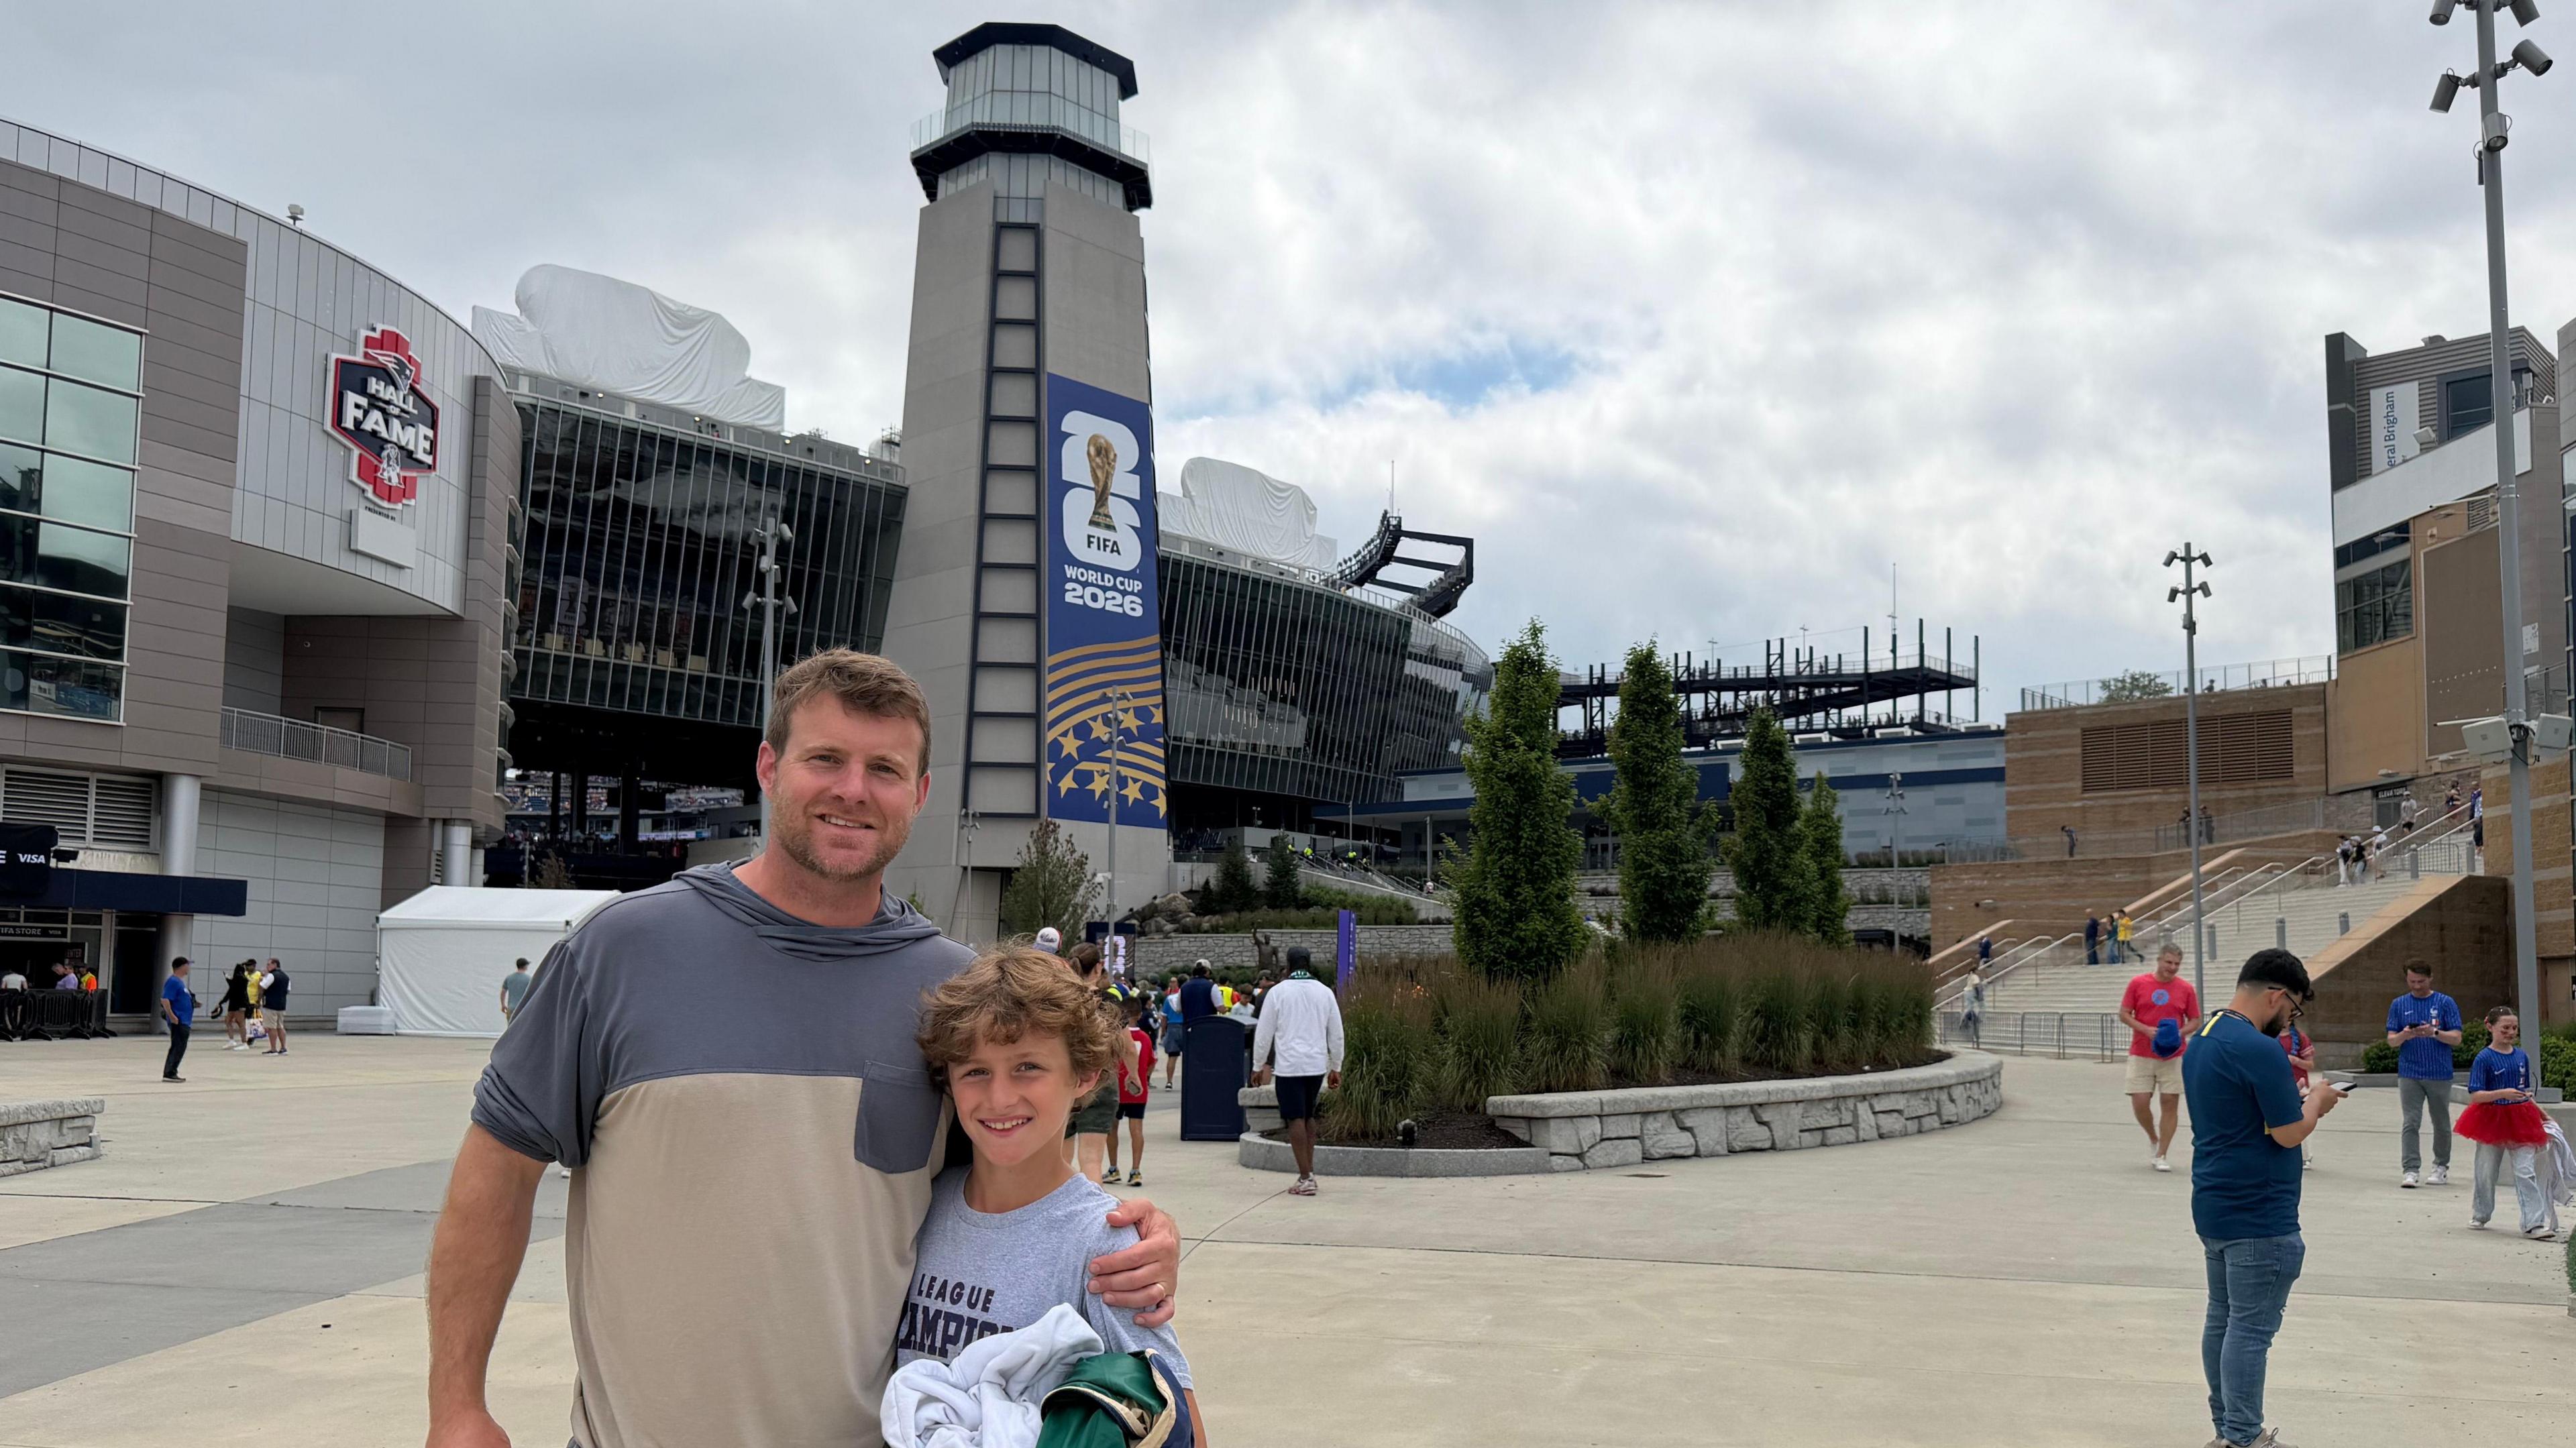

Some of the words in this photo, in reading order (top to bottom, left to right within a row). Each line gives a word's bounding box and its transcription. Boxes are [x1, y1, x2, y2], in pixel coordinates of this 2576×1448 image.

[367, 376, 418, 414] HALL
[386, 405, 401, 415] OF
[341, 390, 434, 465] FAME
[2383, 391, 2398, 441] Brigham
[1087, 534, 1121, 556] FIFA
[1064, 564, 1114, 587] WORLD
[1116, 576, 1142, 594] CUP
[1065, 581, 1143, 617] 2026
[17, 853, 46, 864] VISA
[917, 1274, 995, 1313] LEAGUE
